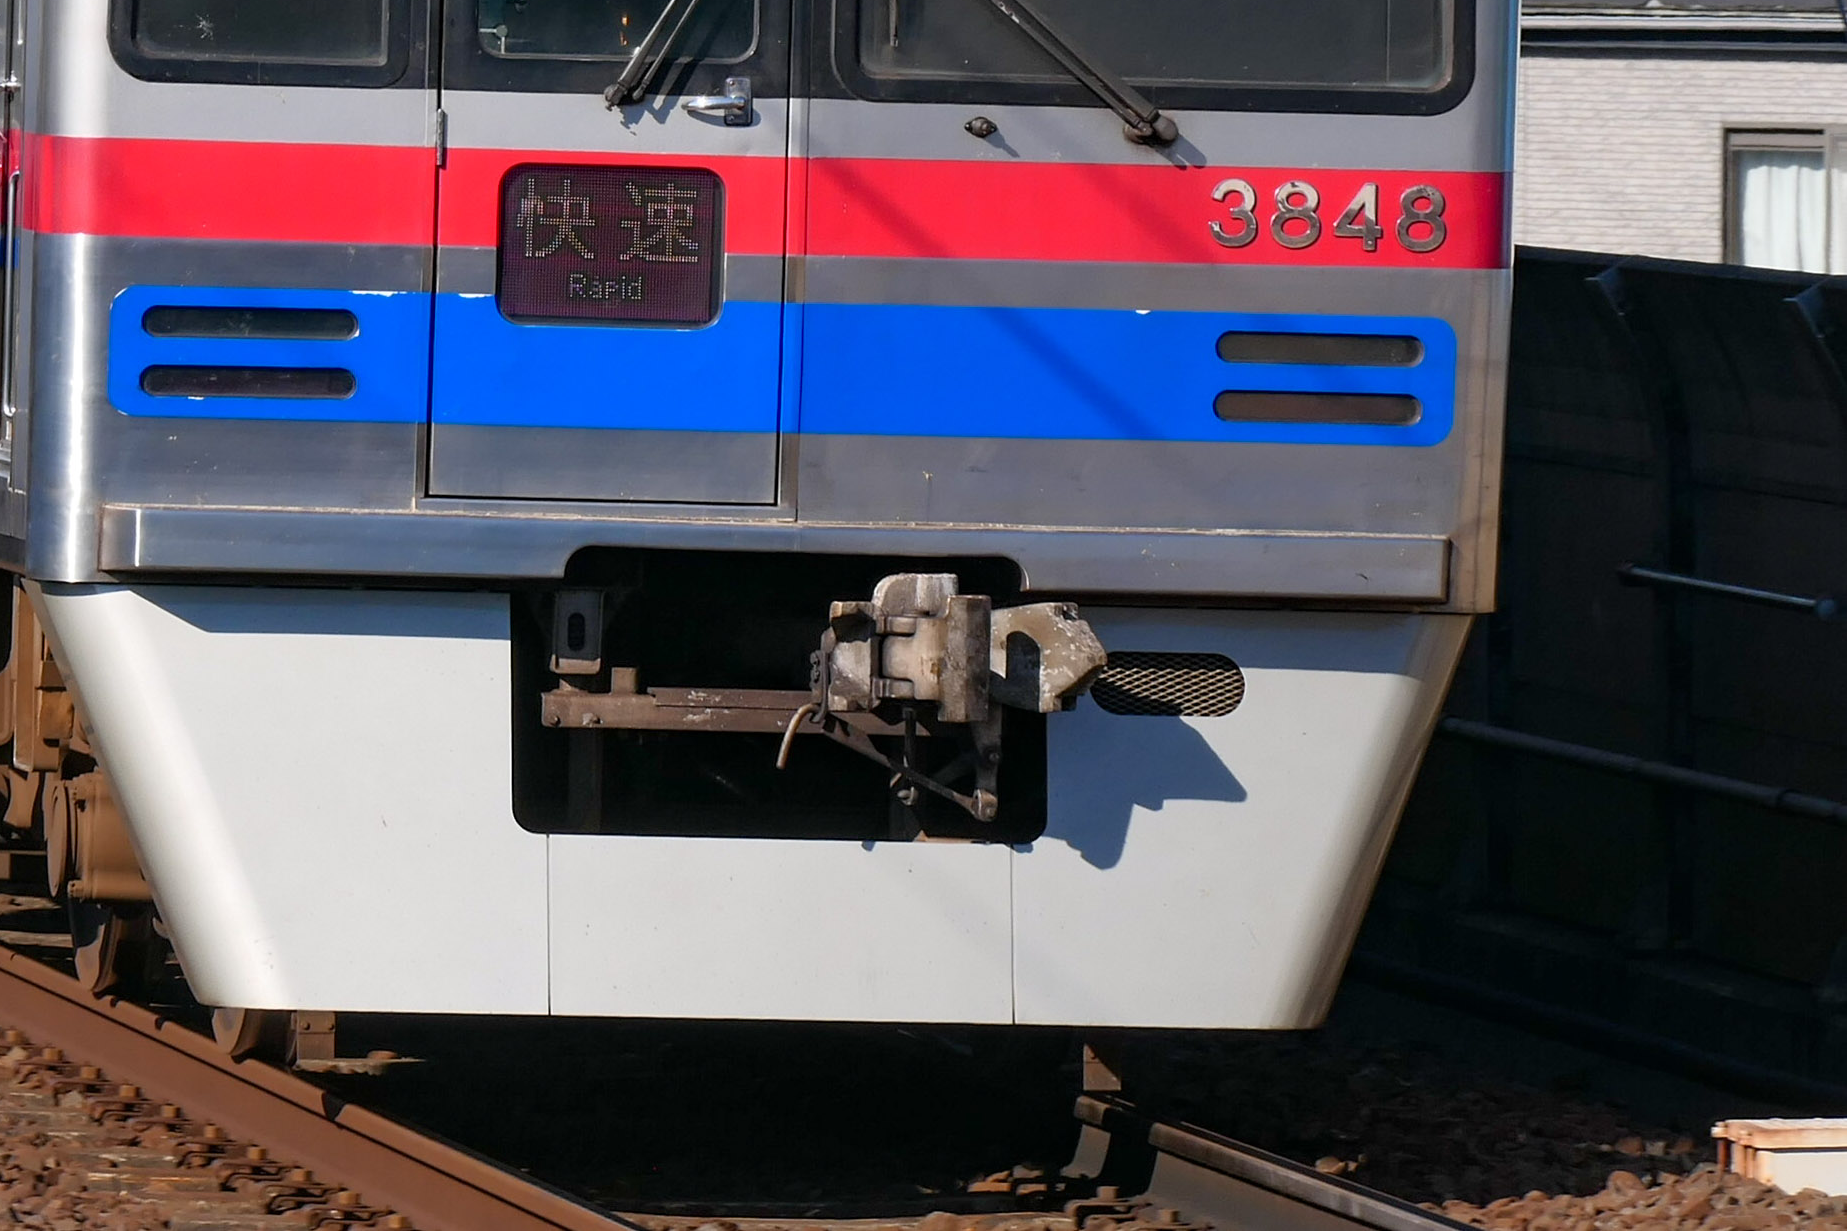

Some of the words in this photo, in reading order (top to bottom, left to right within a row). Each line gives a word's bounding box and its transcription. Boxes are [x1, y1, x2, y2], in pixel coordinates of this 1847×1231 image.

[516, 178, 700, 263] 快速
[1207, 177, 1447, 253] 3848
[569, 273, 643, 300] Rapid
